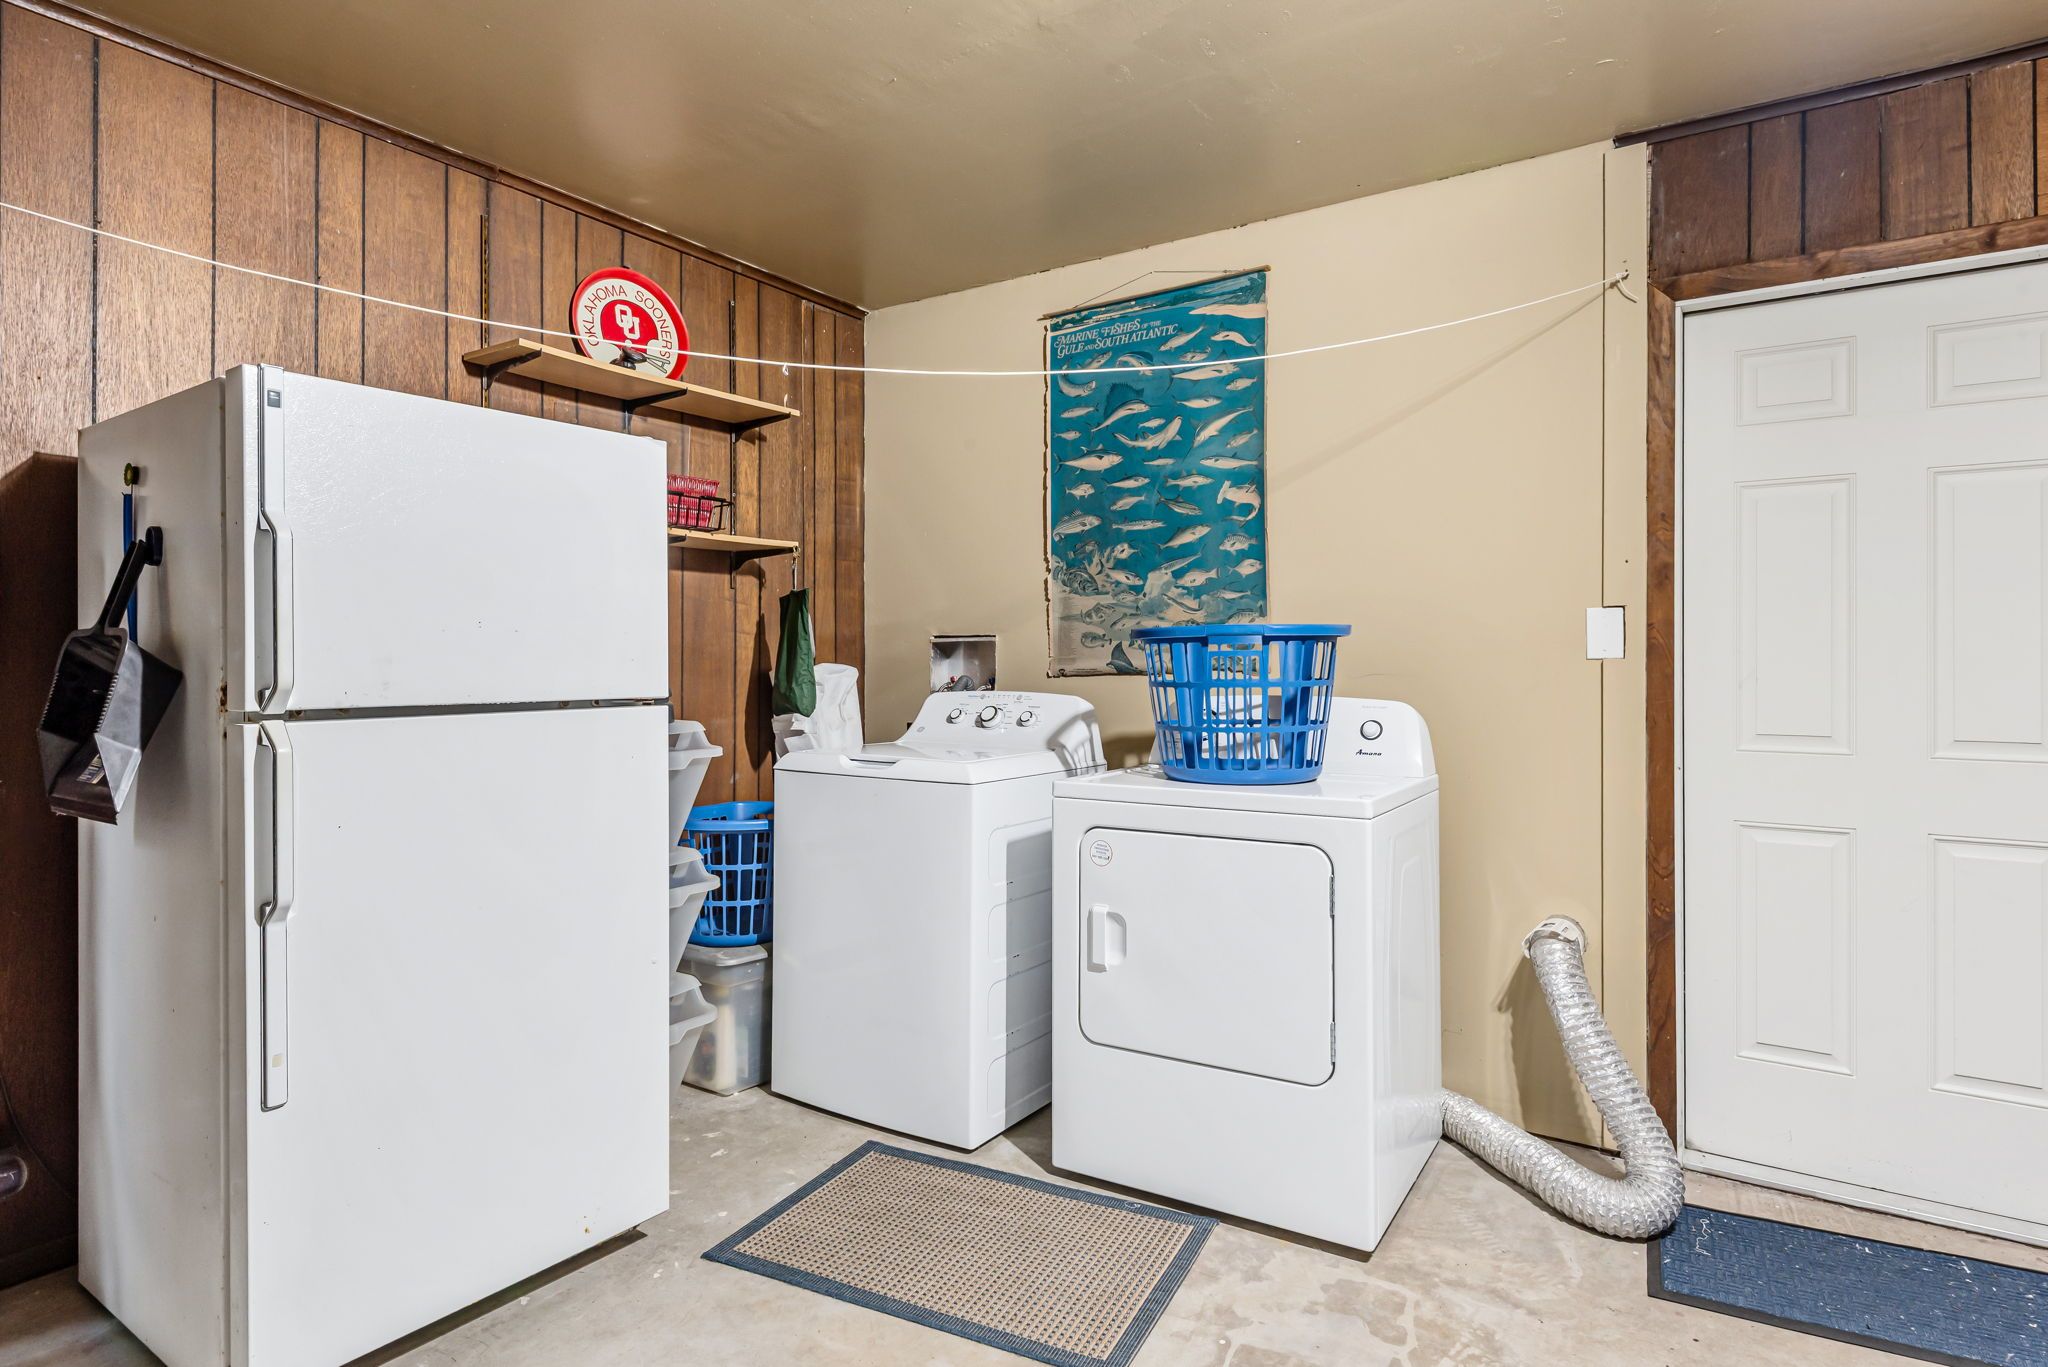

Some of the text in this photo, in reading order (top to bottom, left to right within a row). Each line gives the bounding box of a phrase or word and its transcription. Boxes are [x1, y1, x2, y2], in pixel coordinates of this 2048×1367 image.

[582, 284, 673, 359] OKLAHOMA SOONERS
[614, 304, 641, 340] OU
[1054, 328, 1099, 348] MARINE
[1101, 318, 1141, 337] FISHES
[1057, 342, 1086, 358] GULF
[1094, 334, 1130, 350] SOUTH
[1128, 323, 1179, 342] ATLANTIC
[1355, 748, 1382, 756] Amana
